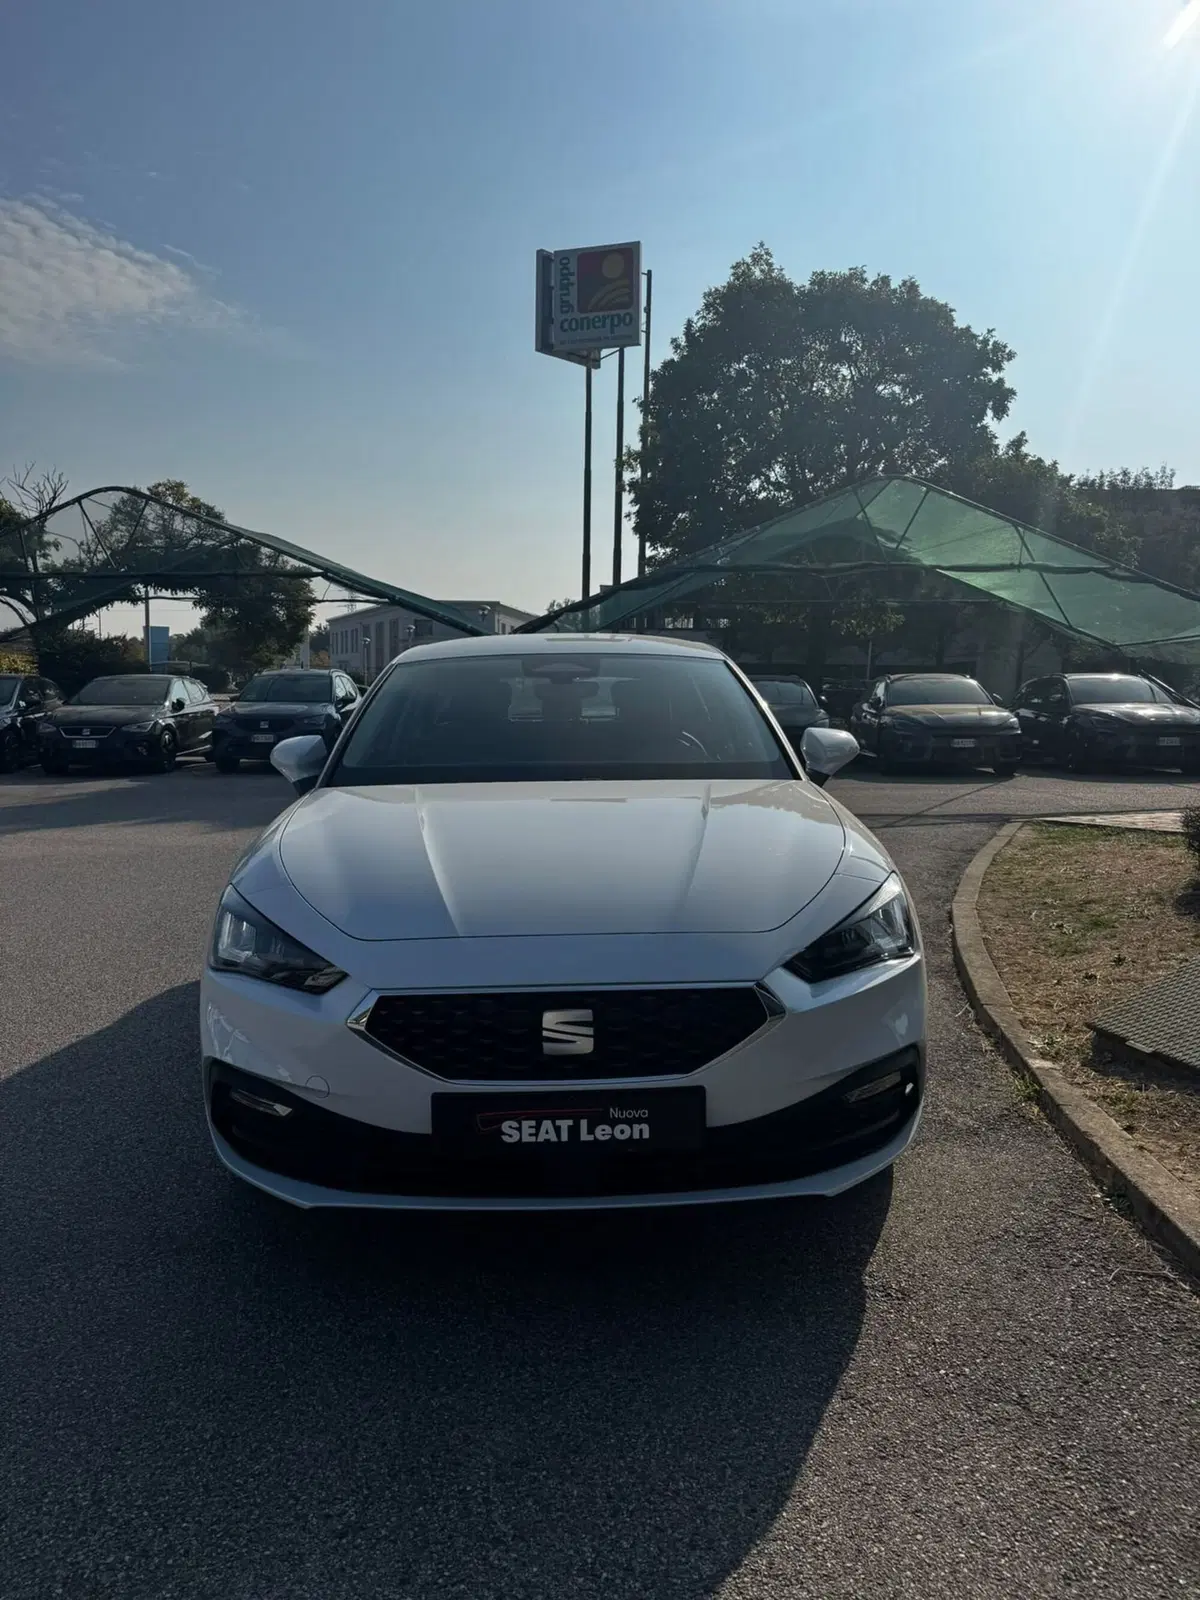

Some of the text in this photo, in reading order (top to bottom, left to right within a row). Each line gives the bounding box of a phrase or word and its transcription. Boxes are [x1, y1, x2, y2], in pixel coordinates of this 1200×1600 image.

[559, 257, 575, 314] gruppo
[560, 312, 633, 334] conerpo
[609, 1107, 649, 1119] Nuova
[501, 1119, 650, 1143] SEAT Leon
